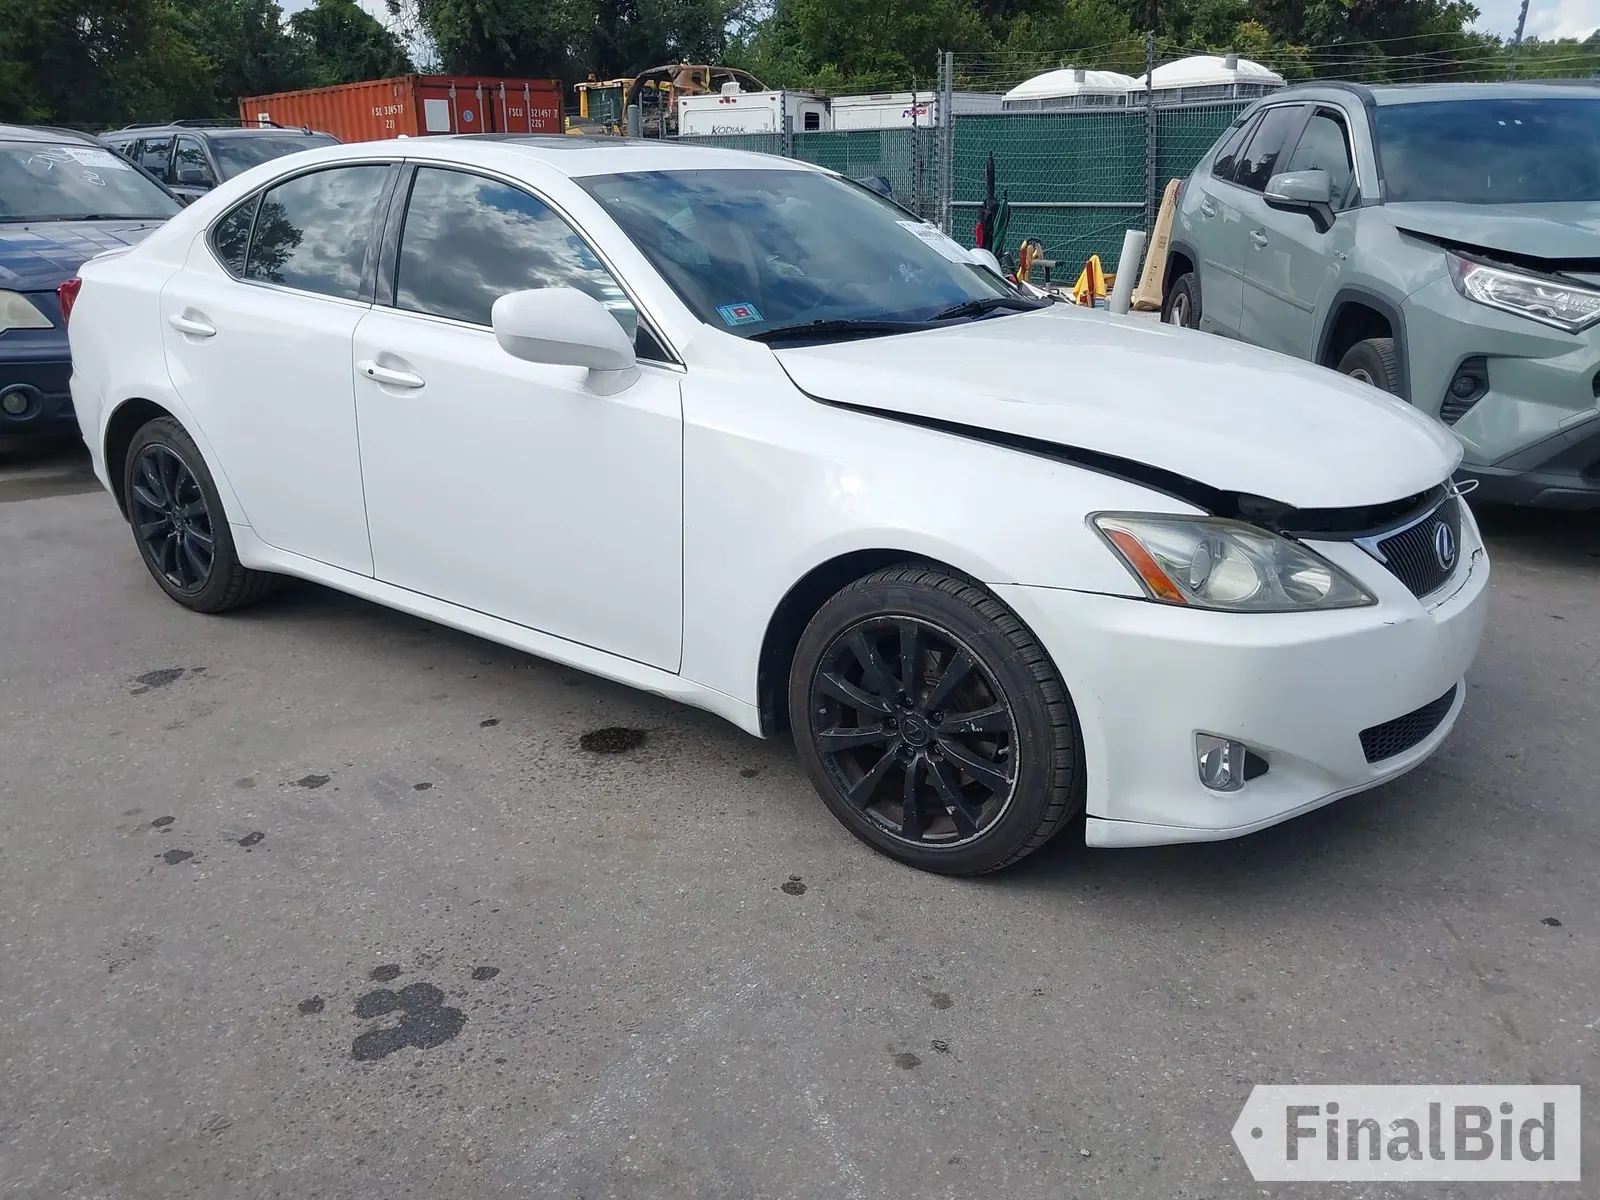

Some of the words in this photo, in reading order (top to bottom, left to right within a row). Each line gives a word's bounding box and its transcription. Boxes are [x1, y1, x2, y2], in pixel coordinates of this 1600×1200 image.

[508, 108, 523, 117] FSCU
[530, 108, 551, 118] 321457
[711, 125, 746, 135] KODIAK
